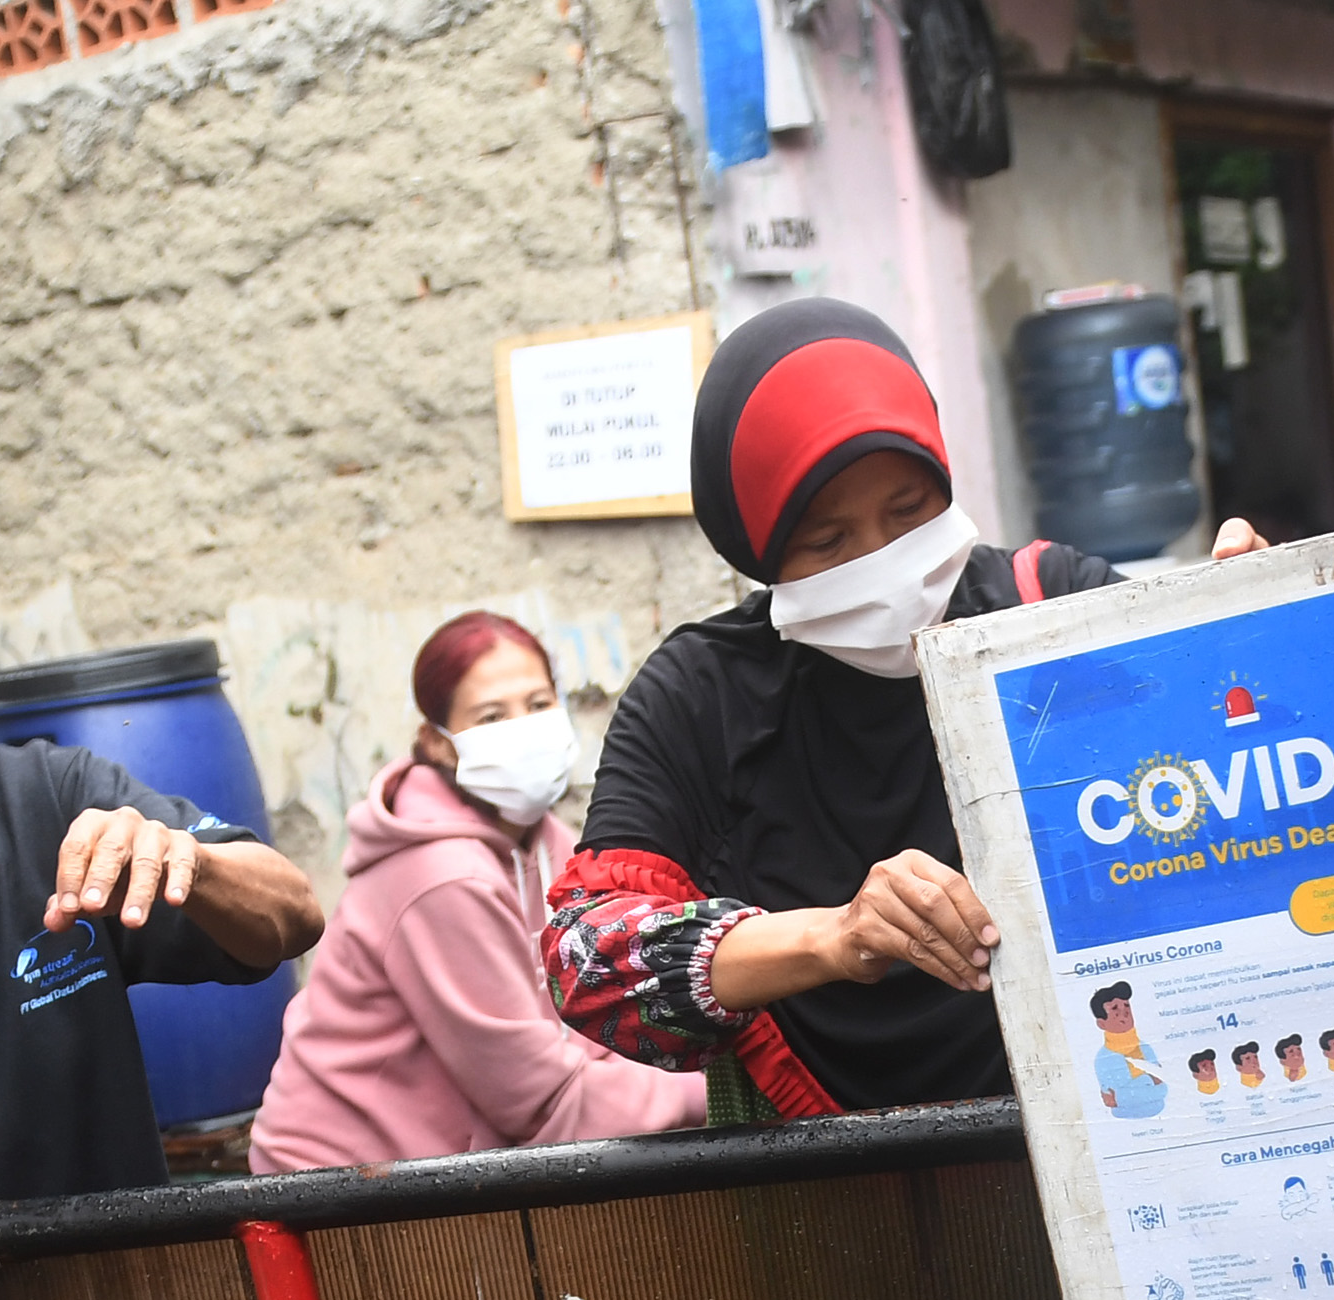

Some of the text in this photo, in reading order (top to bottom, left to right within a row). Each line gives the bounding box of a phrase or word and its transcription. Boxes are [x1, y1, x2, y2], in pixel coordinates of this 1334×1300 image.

[1108, 850, 1207, 886] Corona
[1208, 835, 1284, 865] Virus
[1073, 940, 1223, 976] Gejala Virus Corona
[1216, 1012, 1239, 1031] 14
[1220, 1151, 1258, 1165] Cara
